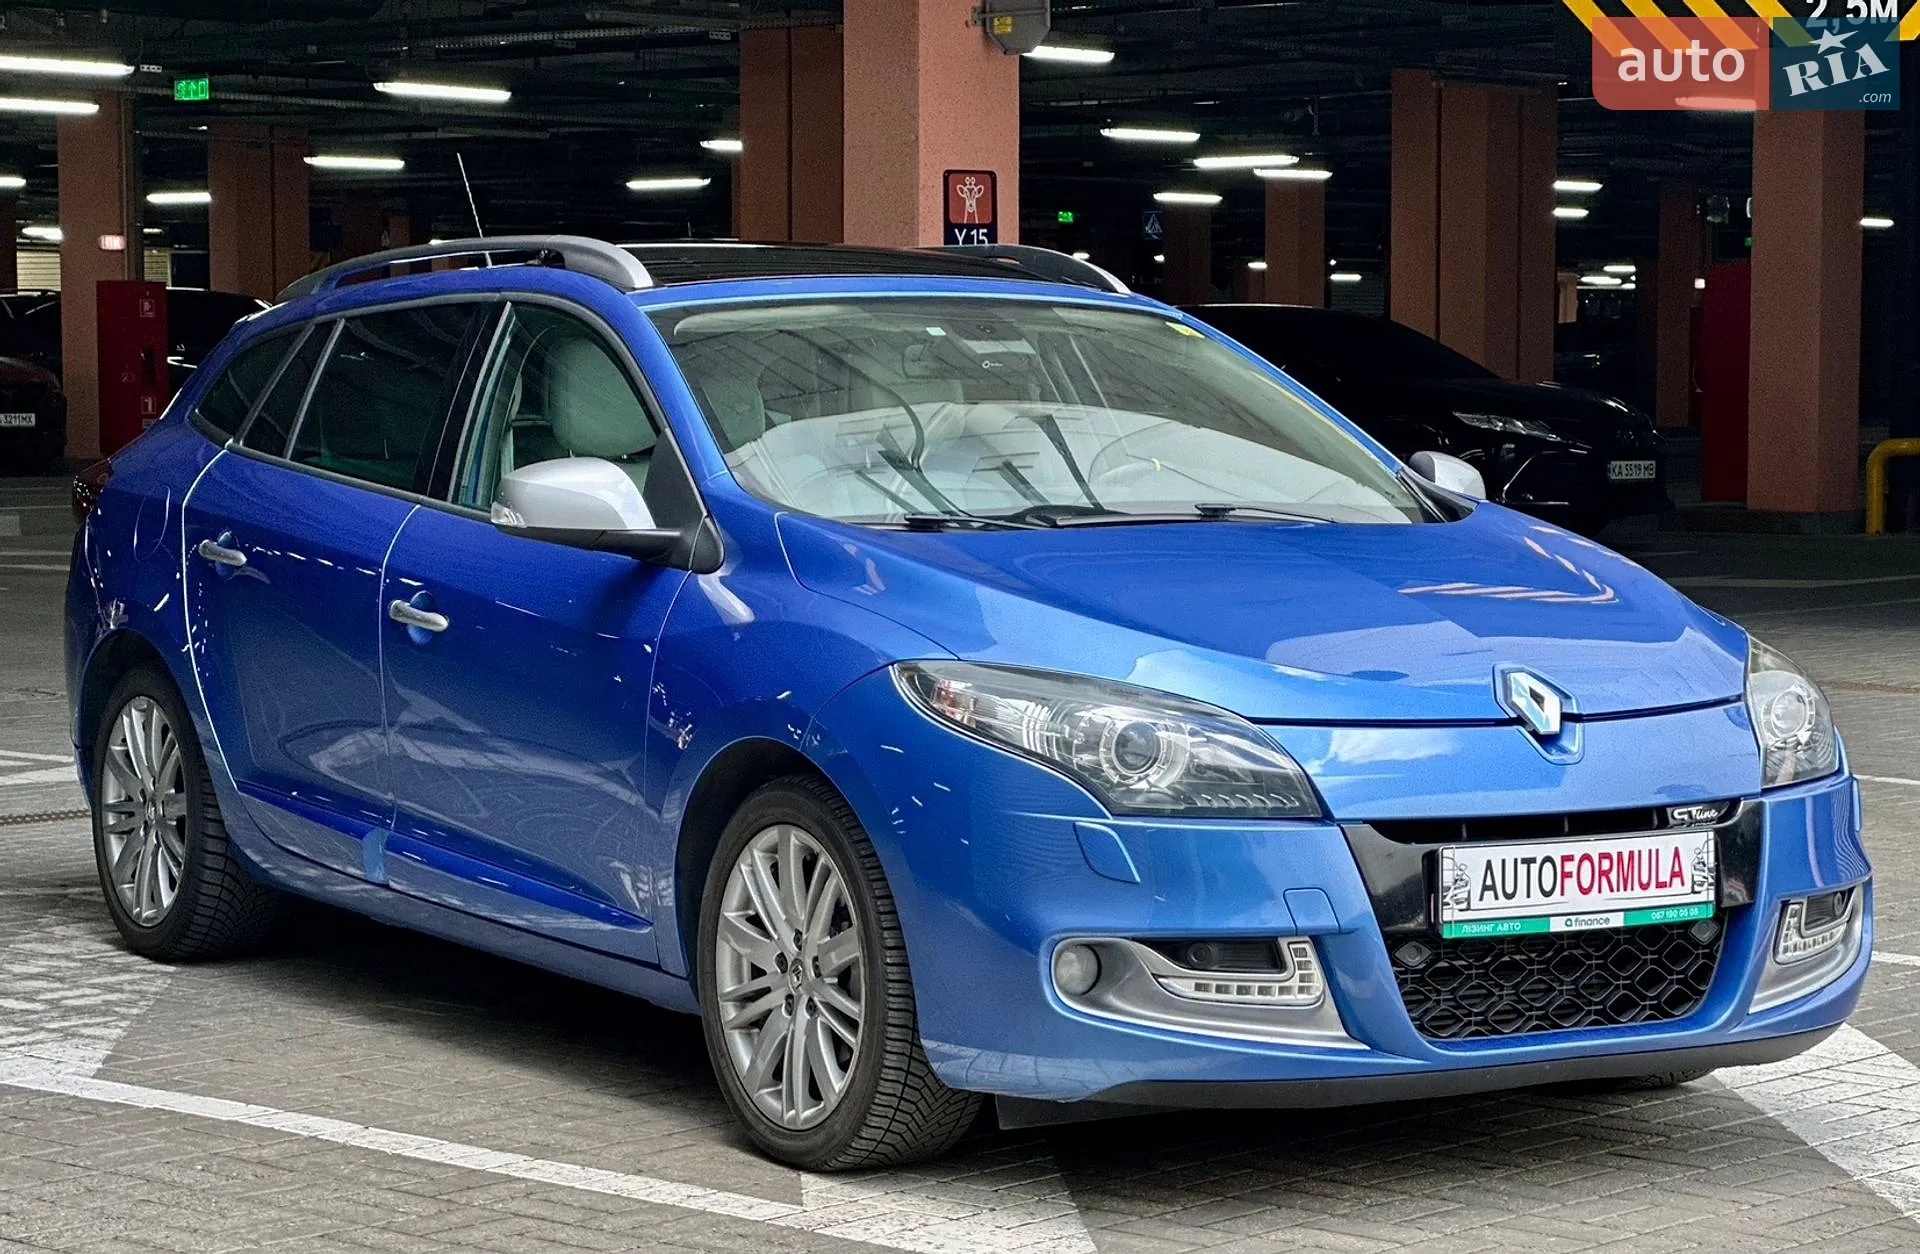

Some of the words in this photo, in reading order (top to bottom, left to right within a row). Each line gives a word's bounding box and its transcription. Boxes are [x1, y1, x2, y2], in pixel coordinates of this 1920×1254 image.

[954, 228, 967, 246] Y
[970, 228, 989, 246] 15
[1478, 846, 1686, 902] AUTOFORMULA
[1574, 916, 1610, 928] finance
